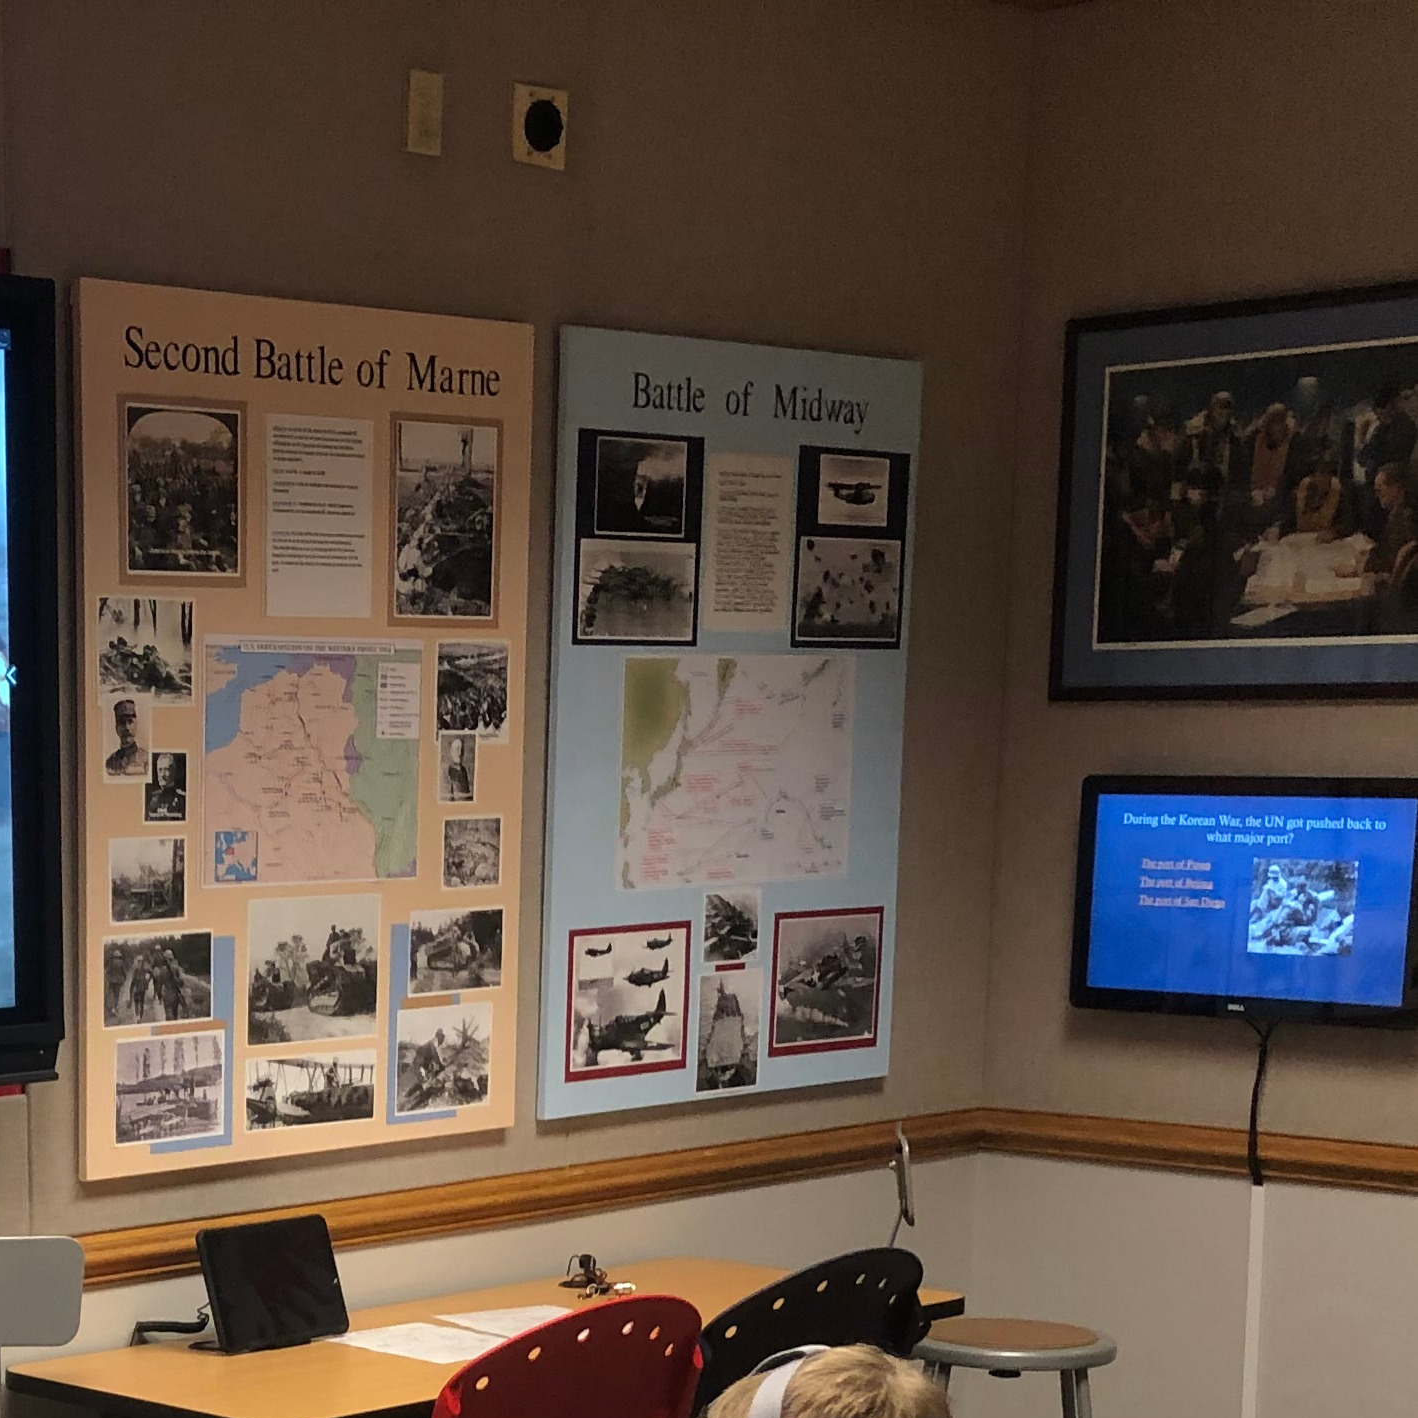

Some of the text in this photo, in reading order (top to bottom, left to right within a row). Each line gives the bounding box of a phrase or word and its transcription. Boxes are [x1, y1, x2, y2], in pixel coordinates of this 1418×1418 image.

[123, 325, 502, 397] Second Battle of Marne
[632, 371, 869, 434] Battle of Midway
[1123, 812, 1387, 831] During the Korean War, the UN got pushed back to
[1207, 830, 1294, 846] what major port?
